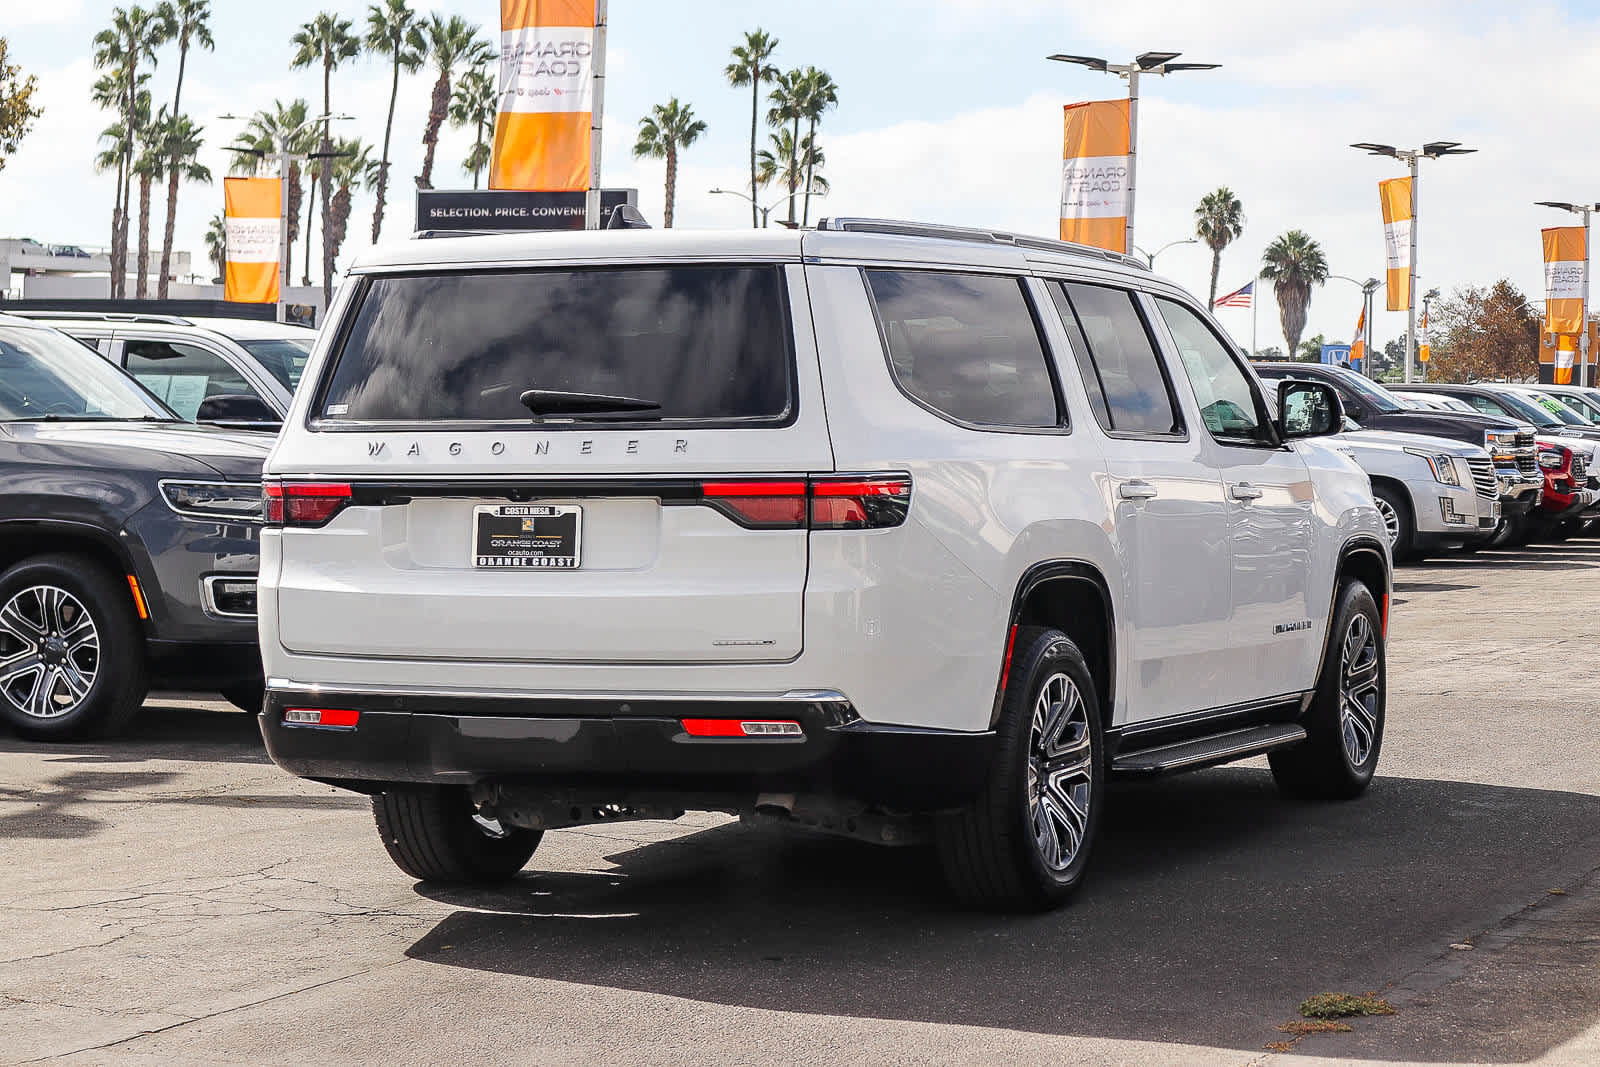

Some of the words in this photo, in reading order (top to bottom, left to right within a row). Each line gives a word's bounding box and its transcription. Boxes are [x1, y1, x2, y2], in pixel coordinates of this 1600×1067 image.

[430, 208, 493, 217] SELECTION.
[495, 207, 530, 217] PRICE.
[367, 439, 689, 457] WAGONEER
[504, 507, 529, 515] COSTA
[530, 507, 550, 515] MESA
[490, 539, 531, 548] ORANGE
[532, 540, 562, 548] COAST
[479, 557, 527, 566] ORANGE
[532, 557, 573, 566] COAST
